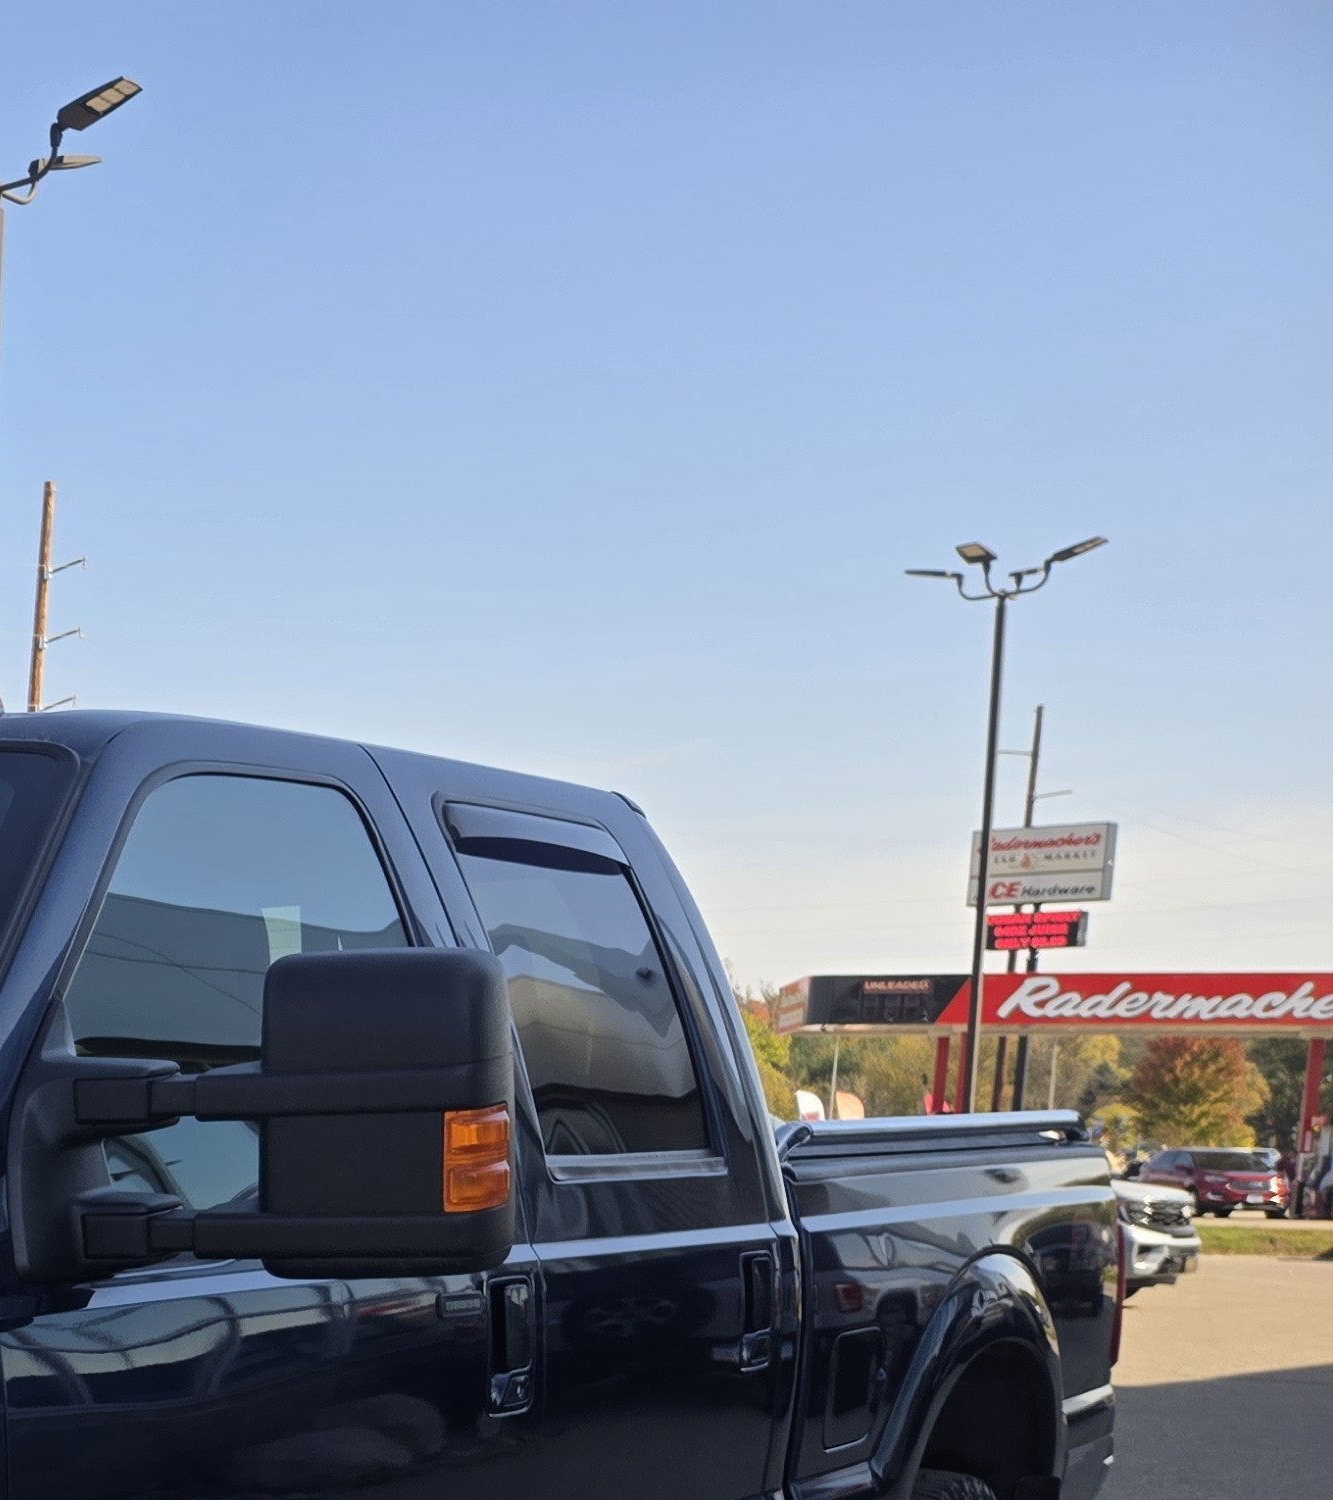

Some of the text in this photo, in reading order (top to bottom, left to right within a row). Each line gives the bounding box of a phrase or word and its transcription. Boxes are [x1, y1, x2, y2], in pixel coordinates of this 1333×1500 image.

[987, 881, 1096, 900] CE Hardware
[863, 979, 930, 991] UNLEADED
